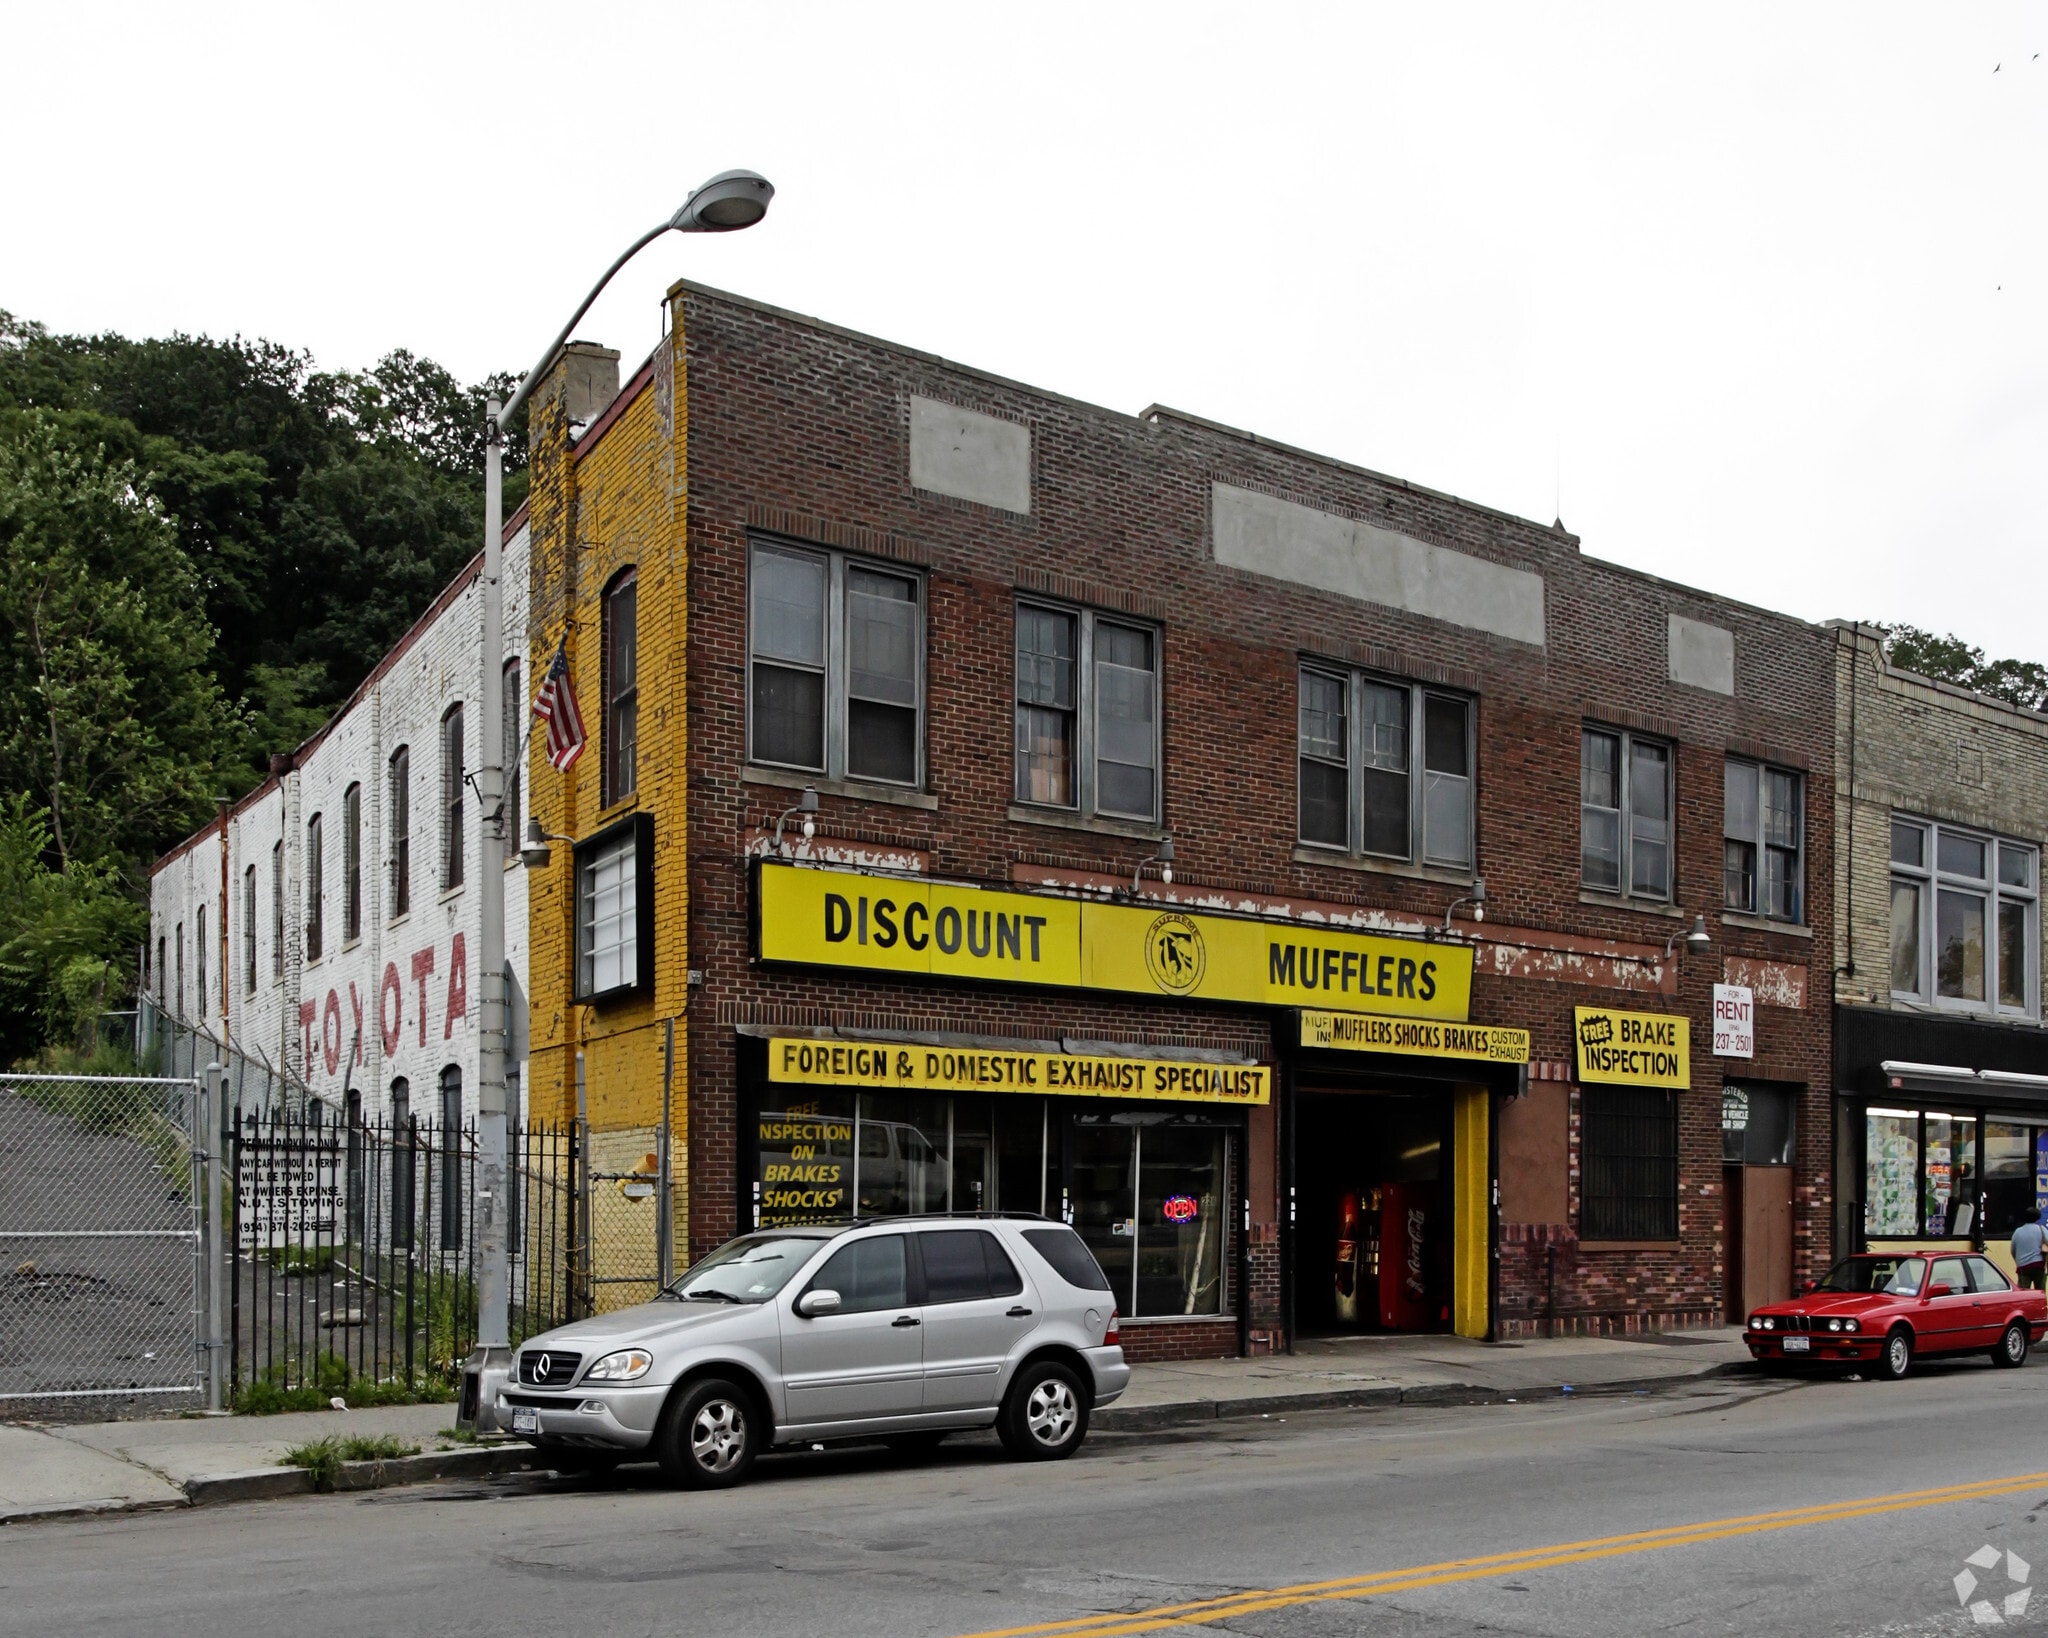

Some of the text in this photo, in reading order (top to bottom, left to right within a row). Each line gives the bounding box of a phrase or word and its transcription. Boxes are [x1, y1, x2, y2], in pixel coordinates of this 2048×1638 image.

[825, 893, 1047, 962] DISCOUNT
[1152, 914, 1200, 937] SUPREME
[1269, 943, 1437, 1001] MUFFLERS
[300, 931, 466, 1086] TOYOTA
[1716, 1000, 1751, 1022] RENT
[1333, 1017, 1489, 1053] MUFFLERS SHOCKS BRAKES
[1491, 1031, 1525, 1045] CUSTOM
[1582, 1019, 1676, 1046] FREE BRAKE
[1489, 1045, 1527, 1060] EXHAUST
[1585, 1047, 1678, 1077] INSPECTION
[783, 1044, 1264, 1098] FOREIGN & DOMESTIC EXHAUST SPECIALIST
[786, 1102, 819, 1122] FREE
[760, 1124, 851, 1140] NSPECTION
[791, 1145, 815, 1161] ON
[308, 1159, 313, 1168] A
[764, 1165, 841, 1182] BRAKES
[242, 1172, 264, 1182] WIL
[282, 1172, 314, 1182] TOWED
[240, 1187, 250, 1196] AT
[762, 1191, 837, 1208] SHOCKS
[290, 1198, 344, 1208] TOWING
[1164, 1199, 1197, 1219] OPEN
